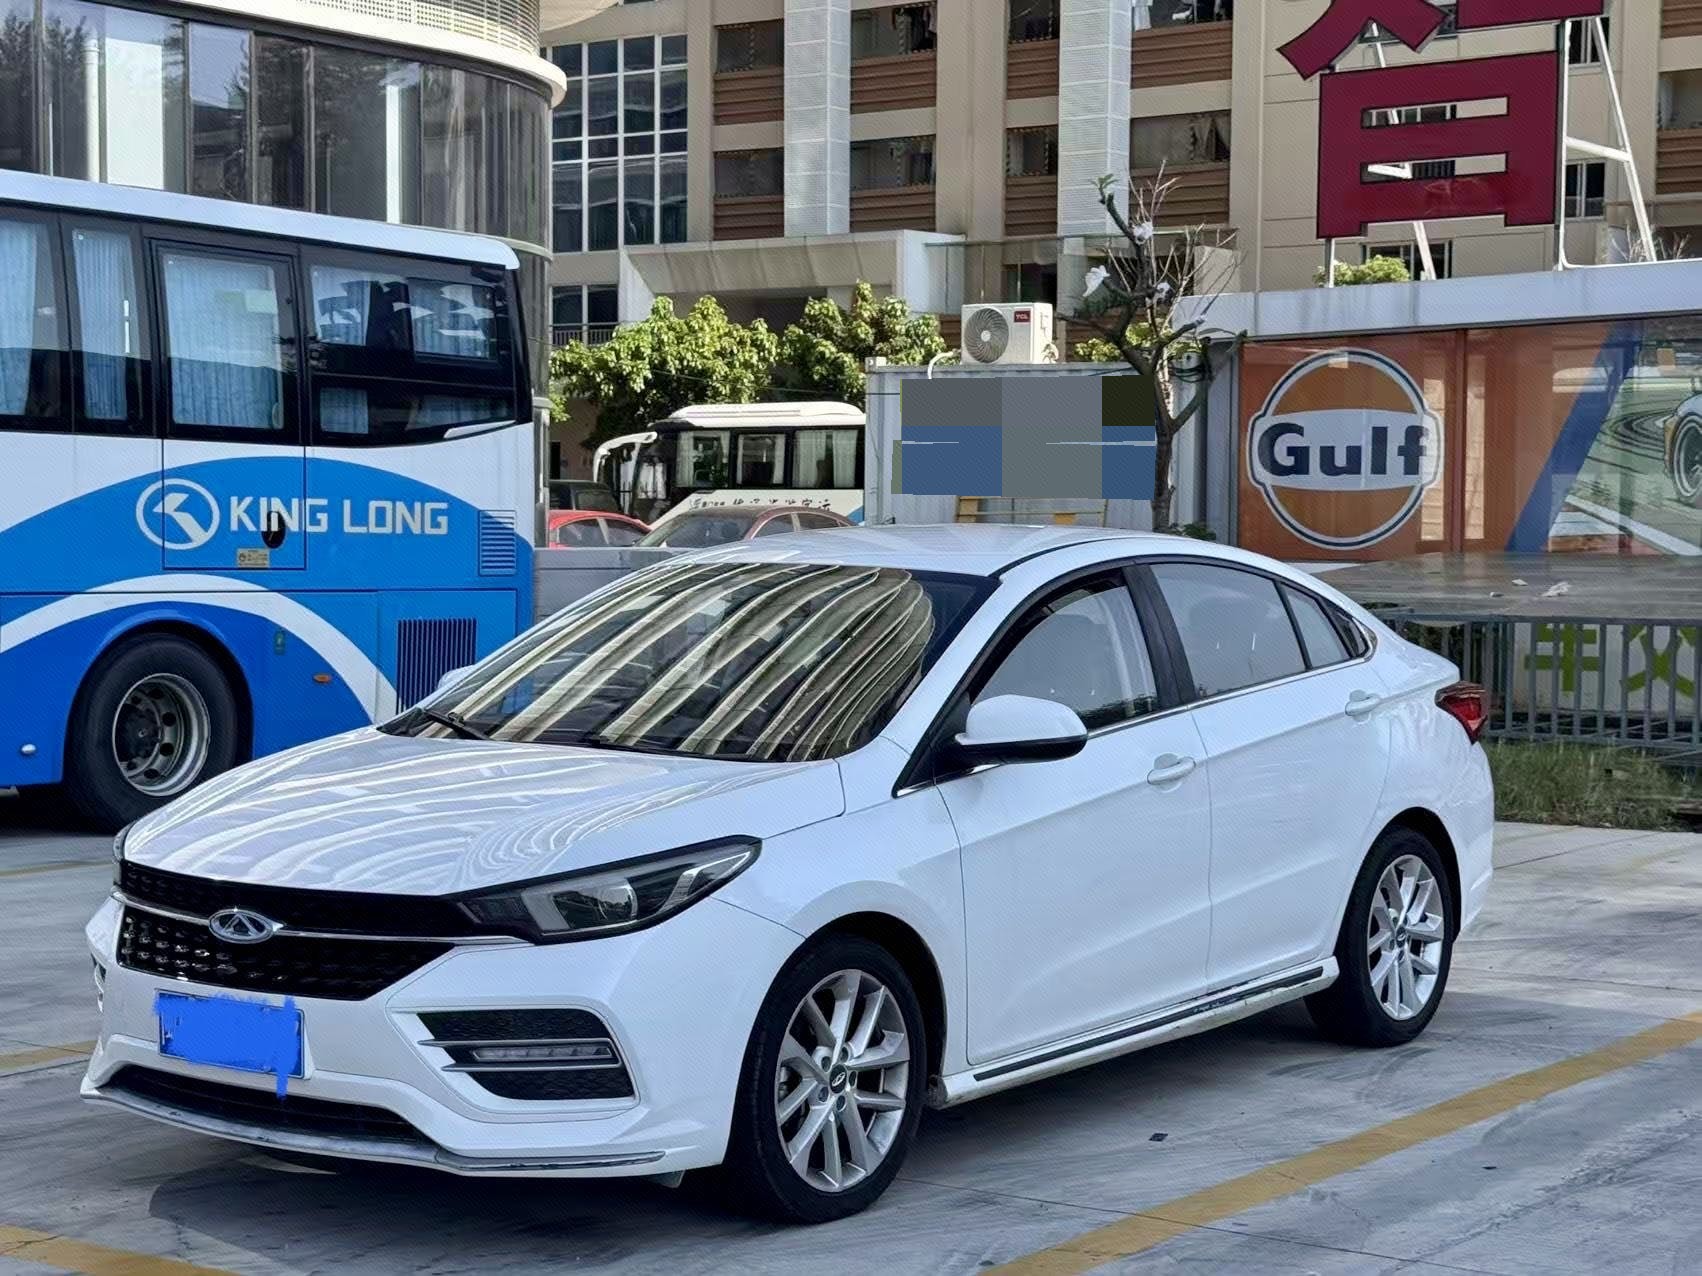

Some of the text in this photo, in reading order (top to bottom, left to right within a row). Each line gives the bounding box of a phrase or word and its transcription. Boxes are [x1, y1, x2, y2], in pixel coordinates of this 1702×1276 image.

[1257, 422, 1429, 477] Gulf
[229, 495, 449, 535] KING LONG
